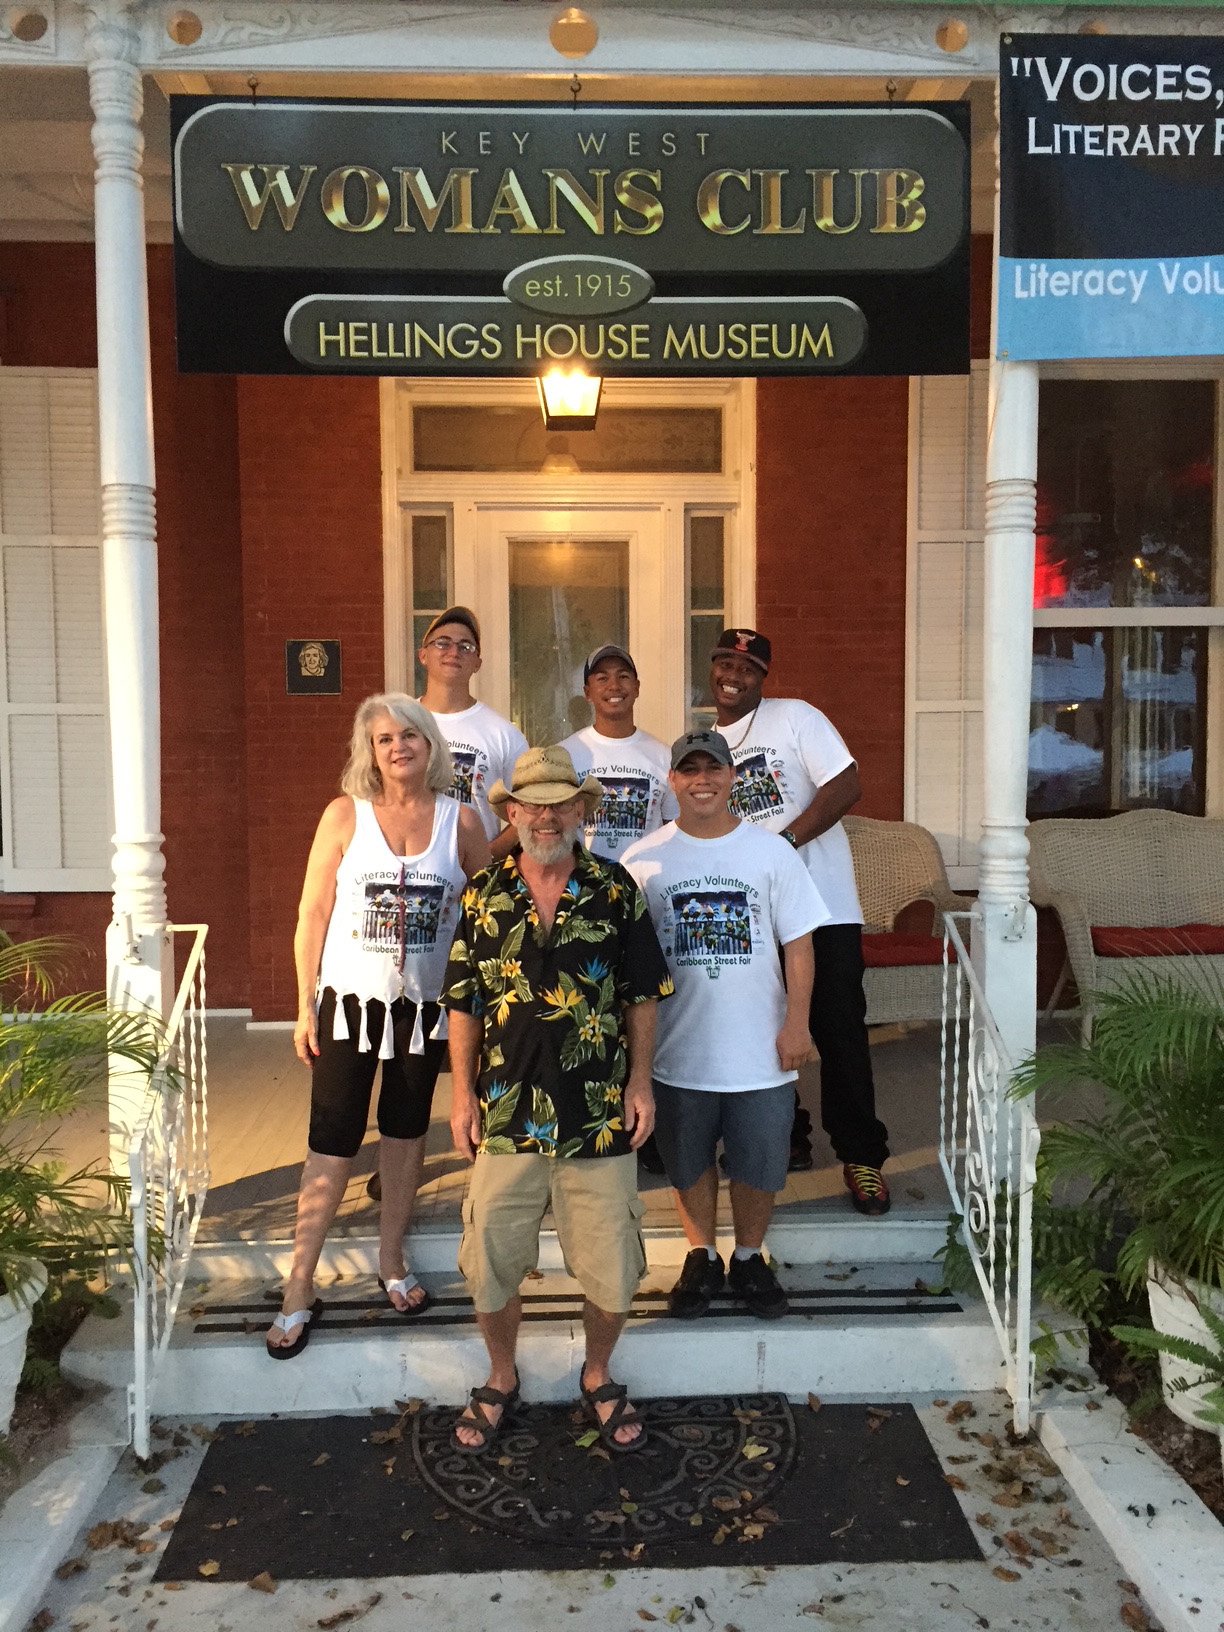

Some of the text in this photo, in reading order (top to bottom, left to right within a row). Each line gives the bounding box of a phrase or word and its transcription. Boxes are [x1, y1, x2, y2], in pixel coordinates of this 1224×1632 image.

[441, 131, 710, 156] KEY WEST
[1027, 116, 1205, 157] LITERARY
[221, 162, 927, 236] WOMANS CLUB
[525, 274, 632, 298] est. 1915
[1014, 262, 1148, 304] Literacy
[319, 321, 834, 361] HELLINGS HOUSE MUSEUM
[446, 740, 488, 761] olunteers
[731, 744, 777, 760] Volunteers
[610, 764, 660, 786] Volunteers
[750, 810, 771, 823] Street
[354, 870, 399, 886] Literacy
[659, 875, 759, 901] Literacy Volunteers
[362, 943, 400, 954] Caribbean
[405, 945, 422, 954] treet
[676, 955, 752, 967] Caribbean Street Fair
